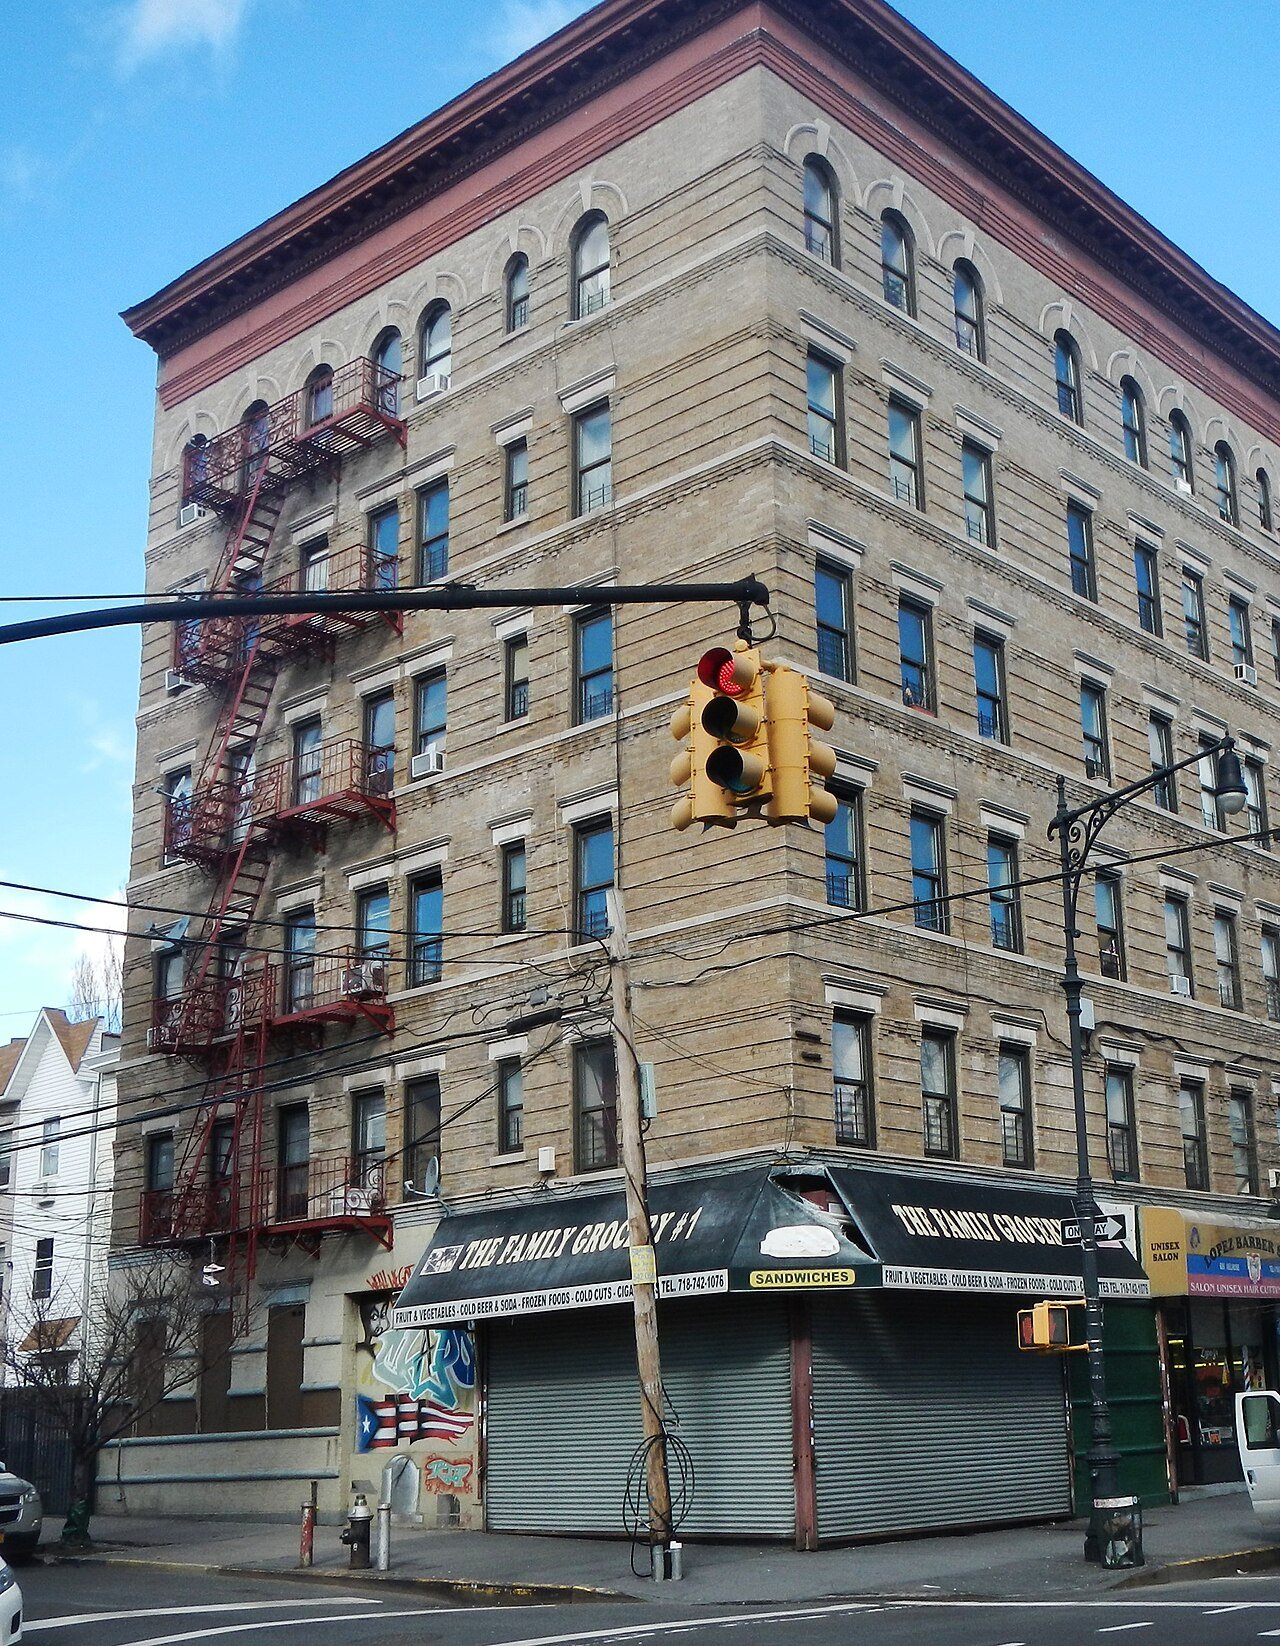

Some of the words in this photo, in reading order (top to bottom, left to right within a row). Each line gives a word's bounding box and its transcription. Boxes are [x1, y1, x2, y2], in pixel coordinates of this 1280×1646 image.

[891, 1204, 940, 1237] THE
[929, 1207, 1001, 1242] FAMILY
[458, 1236, 504, 1271] THE
[496, 1226, 578, 1265] FAMILY
[571, 1211, 676, 1256] GROCY
[669, 1206, 703, 1242] #1
[1150, 1241, 1180, 1251] UNISEX
[1152, 1252, 1179, 1262] SALON
[1204, 1237, 1235, 1269] LOPEZ
[1236, 1235, 1275, 1254] BARBER
[755, 1271, 849, 1285] SANDWICHES
[885, 1269, 903, 1284] FRUIT
[910, 1271, 948, 1286] VEGETABLES
[951, 1274, 967, 1287] COLD
[967, 1274, 982, 1288] BEER
[988, 1276, 1003, 1289] SODA
[1006, 1276, 1028, 1290] FROZEN
[1028, 1277, 1046, 1290] FOODS
[1049, 1278, 1063, 1291] COLD
[1190, 1281, 1216, 1293] SALON
[1216, 1283, 1243, 1294] UNISEX
[1243, 1285, 1260, 1294] HAIR
[395, 1310, 412, 1324] FRUIT
[420, 1305, 456, 1321] VEGETABLES
[460, 1303, 477, 1316] COLD
[477, 1300, 493, 1314] BEER
[500, 1298, 517, 1311] SODA
[521, 1294, 547, 1309] FROZEN
[549, 1291, 571, 1306] FOODS
[575, 1289, 593, 1303] COLD
[594, 1286, 612, 1301] CUTS
[662, 1279, 677, 1293] TEL.
[678, 1274, 724, 1291] 718-742-1076
